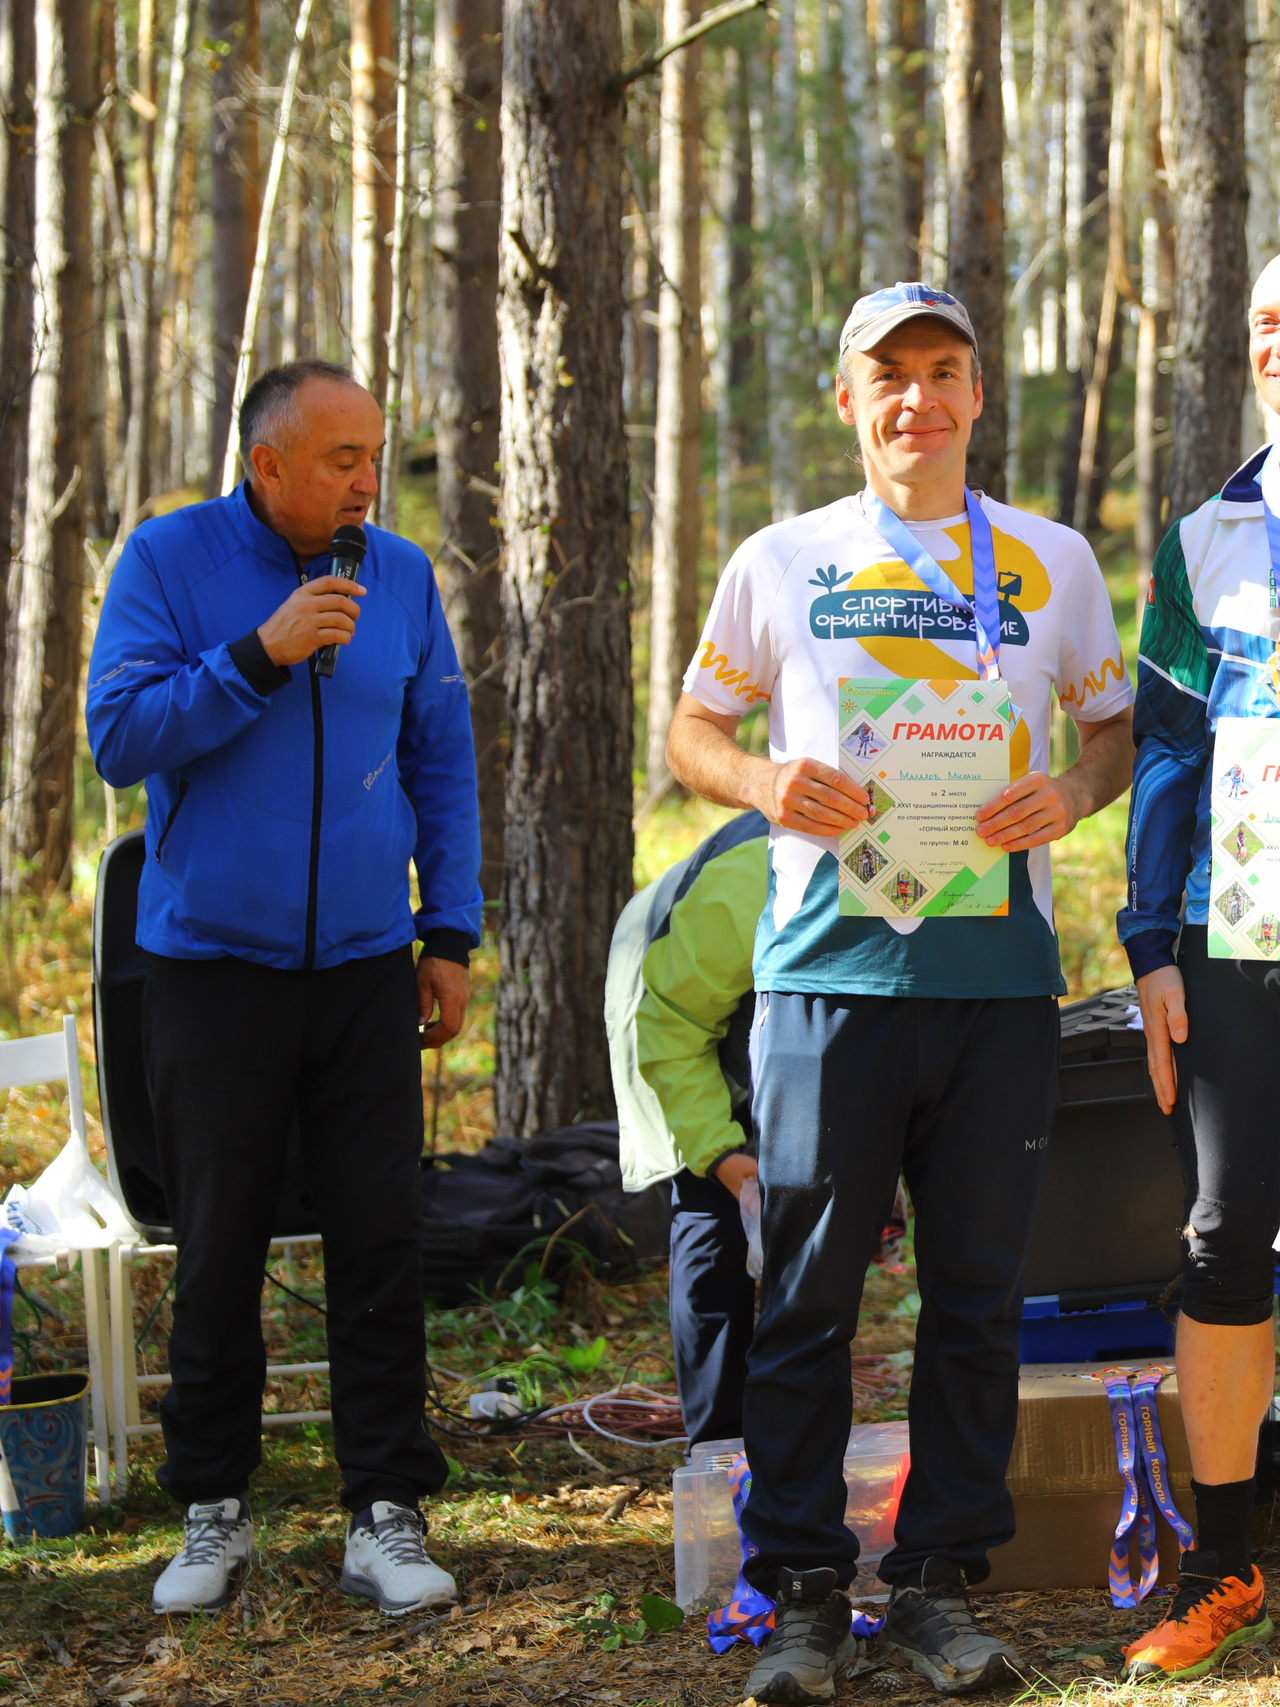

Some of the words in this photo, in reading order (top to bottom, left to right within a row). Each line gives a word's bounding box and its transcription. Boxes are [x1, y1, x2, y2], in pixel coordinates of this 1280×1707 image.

[892, 722, 1004, 741] ГРАМОТА
[921, 751, 976, 759] НАГРАЖДАЕТСЯ
[941, 789, 946, 797] 2
[1118, 1412, 1130, 1460] ГОРНЫЙ
[1141, 1406, 1158, 1454] ГОРНЫЙ
[1151, 1458, 1166, 1504] КОРОЛЬ
